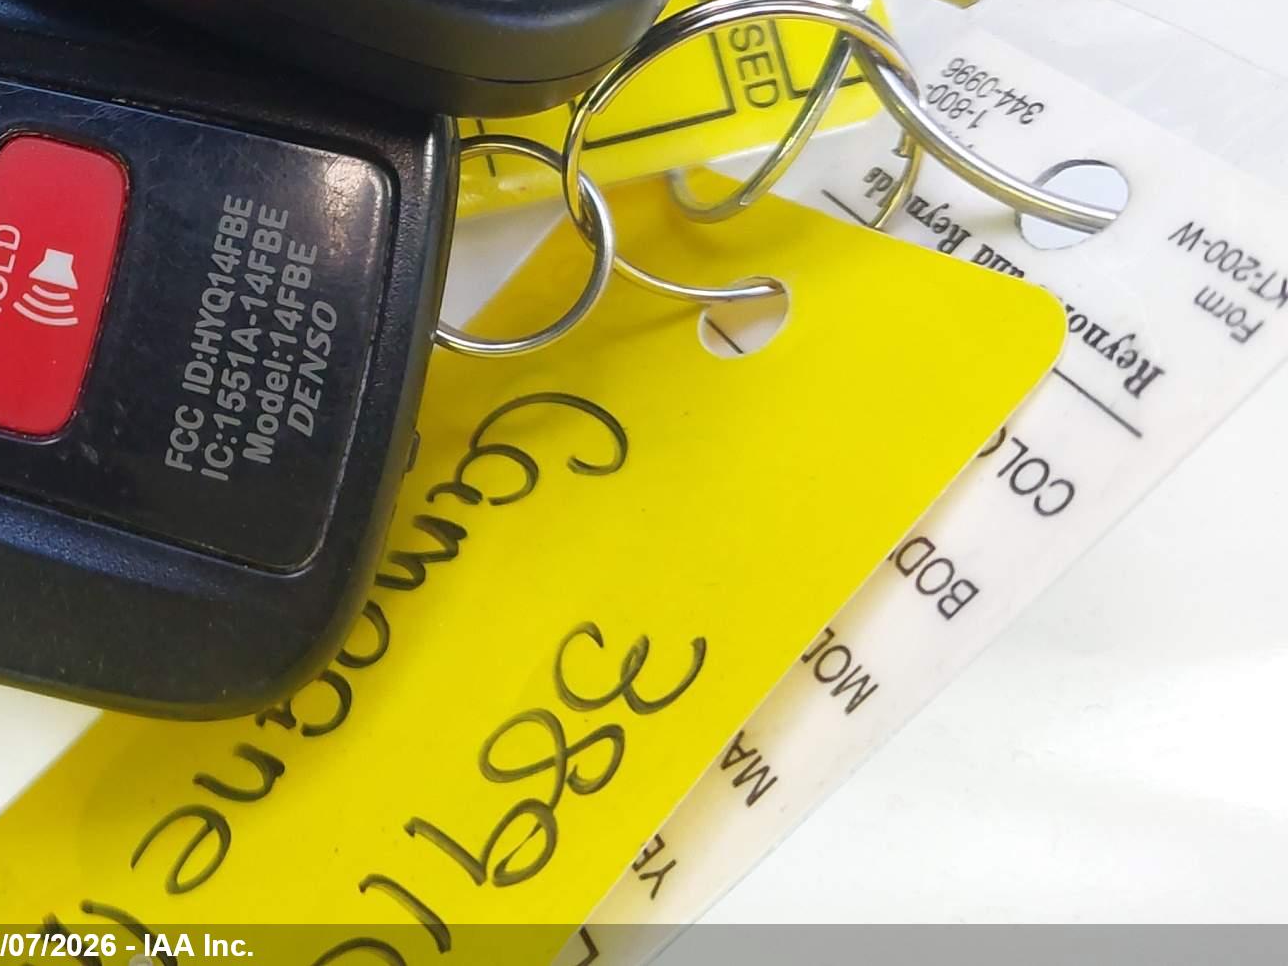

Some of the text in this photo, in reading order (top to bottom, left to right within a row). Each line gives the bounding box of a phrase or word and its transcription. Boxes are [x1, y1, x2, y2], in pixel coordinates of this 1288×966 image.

[925, 83, 989, 130] 1-800-
[941, 57, 1045, 125] 344-0996
[864, 166, 971, 255] Reynlds
[165, 194, 253, 472] FCC ID:HYQ14FBE
[200, 204, 289, 482] IC:1551A-14FBE
[242, 240, 318, 464] Model:14FBE
[1057, 299, 1165, 399] Reyno
[1193, 285, 1265, 344] Form
[286, 300, 338, 437] DENSO
[887, 536, 980, 621] BOD
